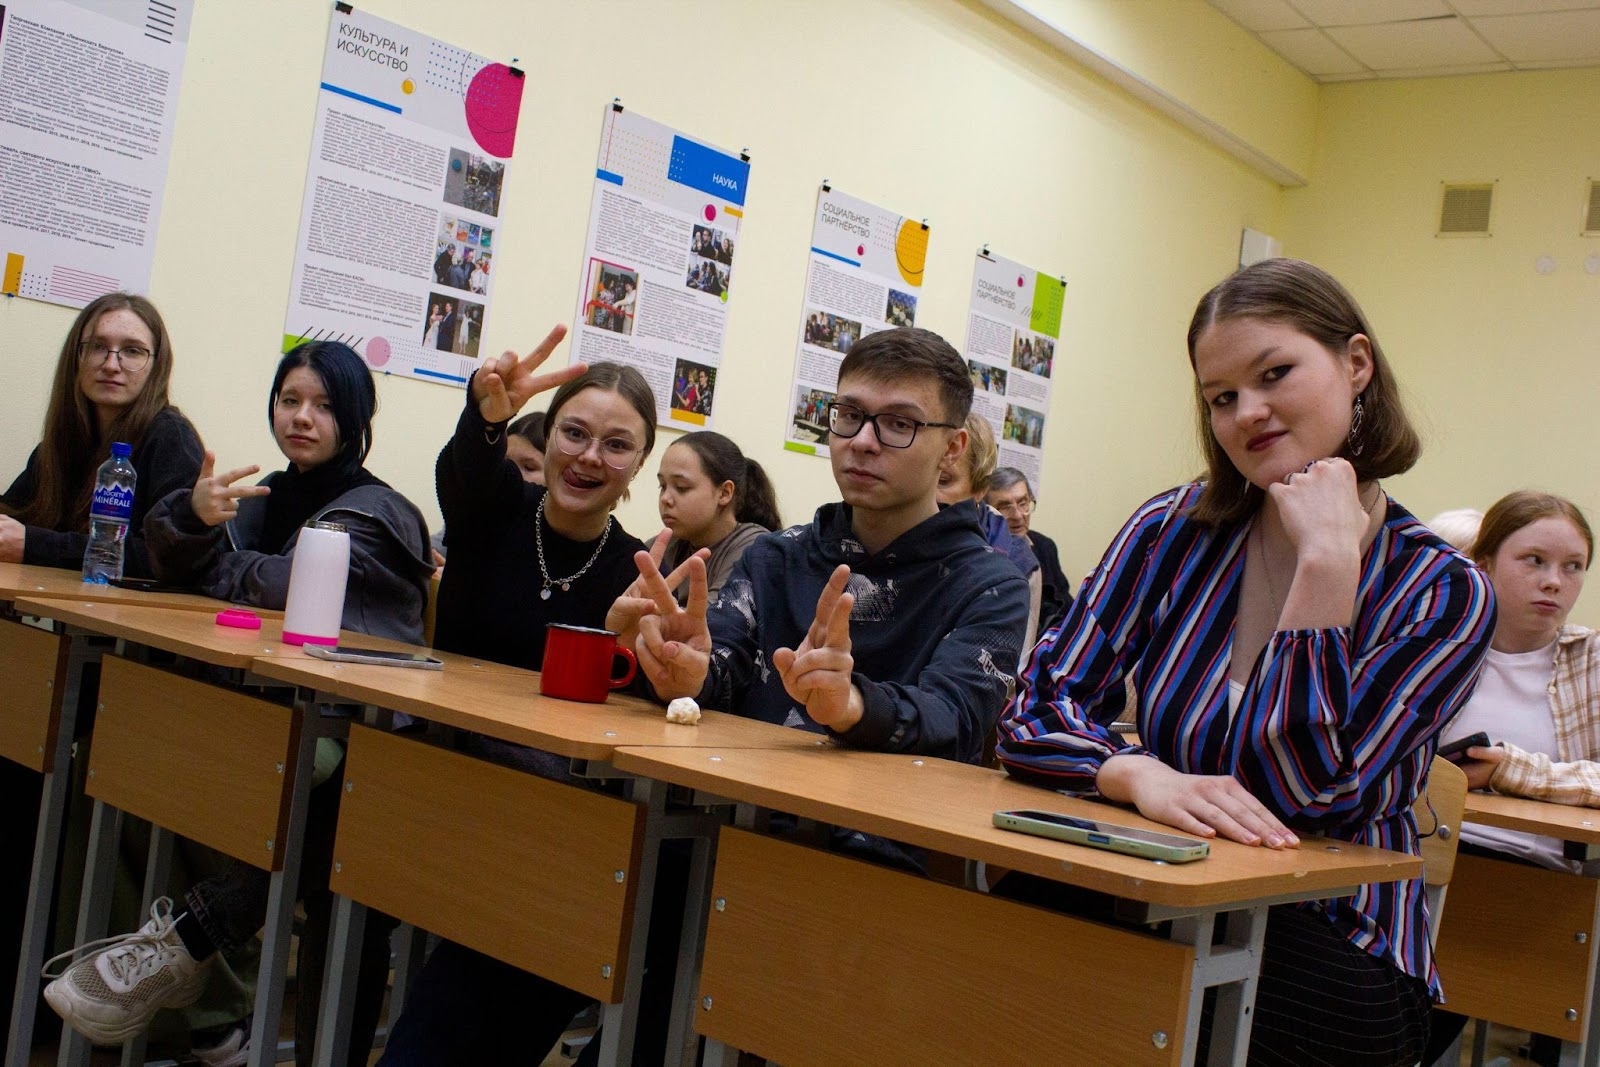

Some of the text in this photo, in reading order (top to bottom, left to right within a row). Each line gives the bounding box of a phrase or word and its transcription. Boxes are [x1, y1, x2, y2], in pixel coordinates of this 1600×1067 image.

[339, 22, 409, 57] КУЛЬТУРА И
[337, 38, 408, 72] ИСКУССТВО
[712, 172, 738, 191] НАУКА
[823, 201, 870, 227] СОЦИАЛЬНОЕ
[978, 279, 1016, 299] СОЦИАЛЬНОЕ
[94, 495, 130, 508] MINÉRALE
